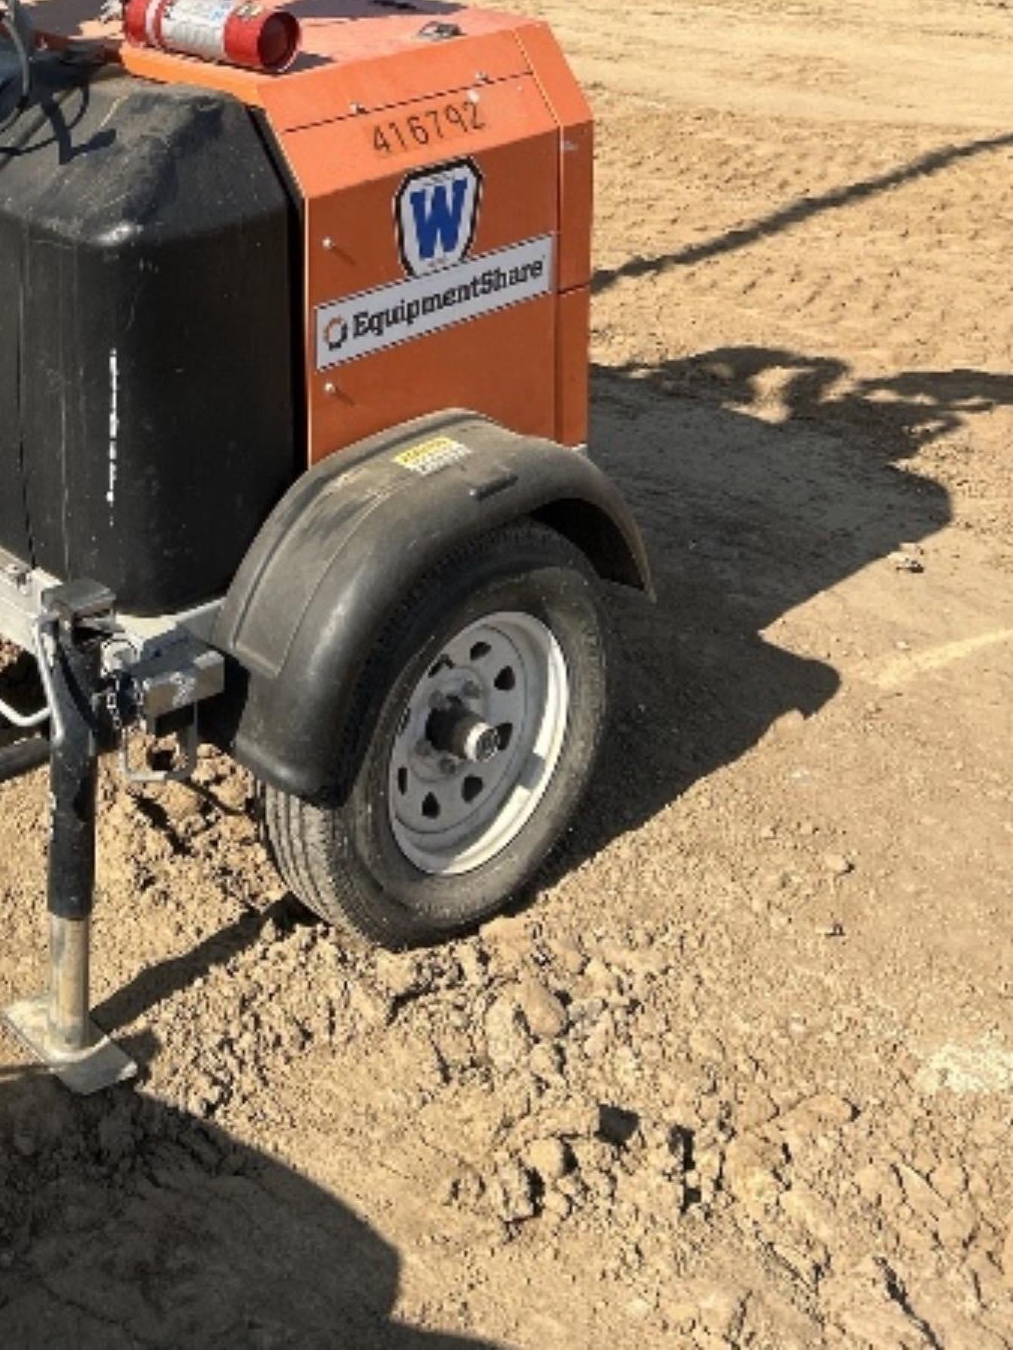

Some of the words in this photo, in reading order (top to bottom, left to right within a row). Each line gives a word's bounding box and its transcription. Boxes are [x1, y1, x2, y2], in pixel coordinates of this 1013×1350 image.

[372, 101, 488, 154] 416792
[409, 177, 469, 260] W
[352, 260, 545, 338] EquipmentShare
